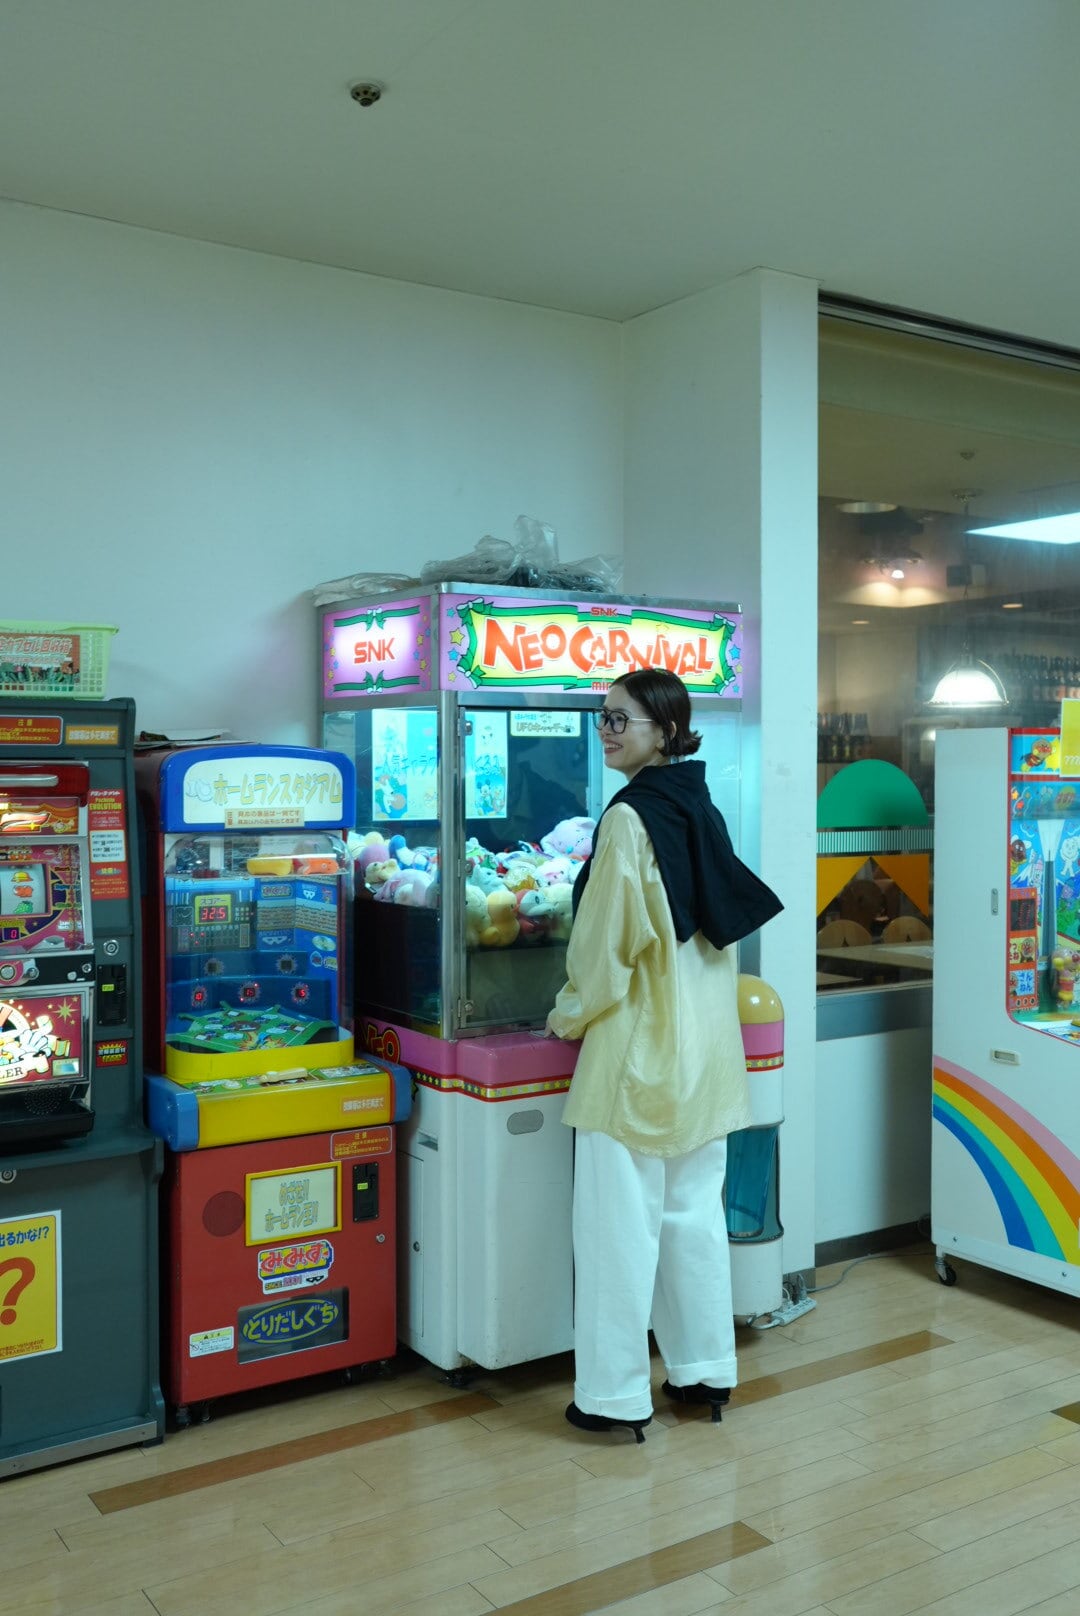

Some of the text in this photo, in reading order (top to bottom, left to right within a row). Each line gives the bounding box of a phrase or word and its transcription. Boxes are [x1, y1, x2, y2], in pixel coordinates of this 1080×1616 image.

[591, 607, 617, 617] SNK
[353, 637, 395, 664] SNK
[212, 773, 342, 805] ホームランスタジアム
[10, 929, 17, 939] 0
[248, 1303, 334, 1340] とりだしぐち
